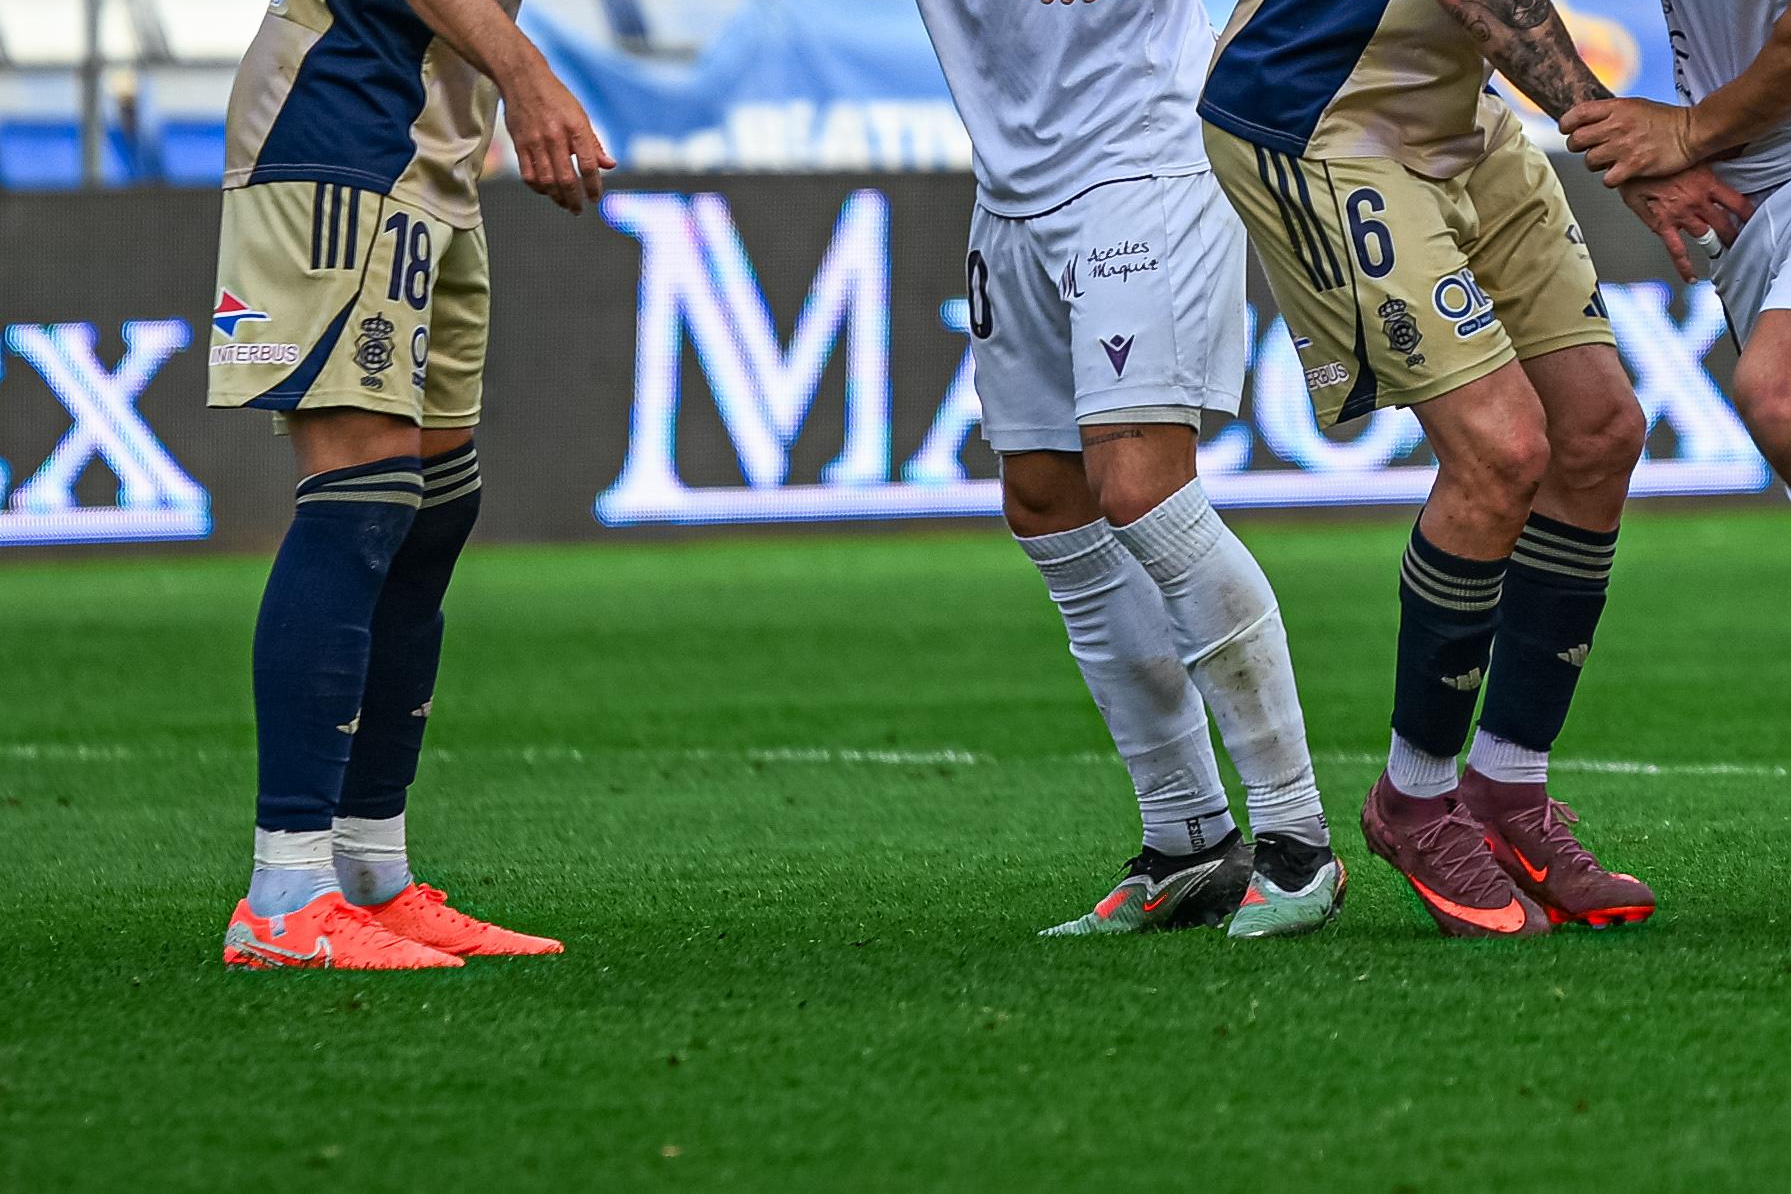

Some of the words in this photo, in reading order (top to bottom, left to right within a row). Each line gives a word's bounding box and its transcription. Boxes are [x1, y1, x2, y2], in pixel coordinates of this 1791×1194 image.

[1346, 188, 1395, 278] 6
[382, 211, 432, 311] 18
[1087, 241, 1151, 264] Aceites
[211, 344, 299, 365] INTERBUS
[1307, 363, 1348, 388] ERBUS
